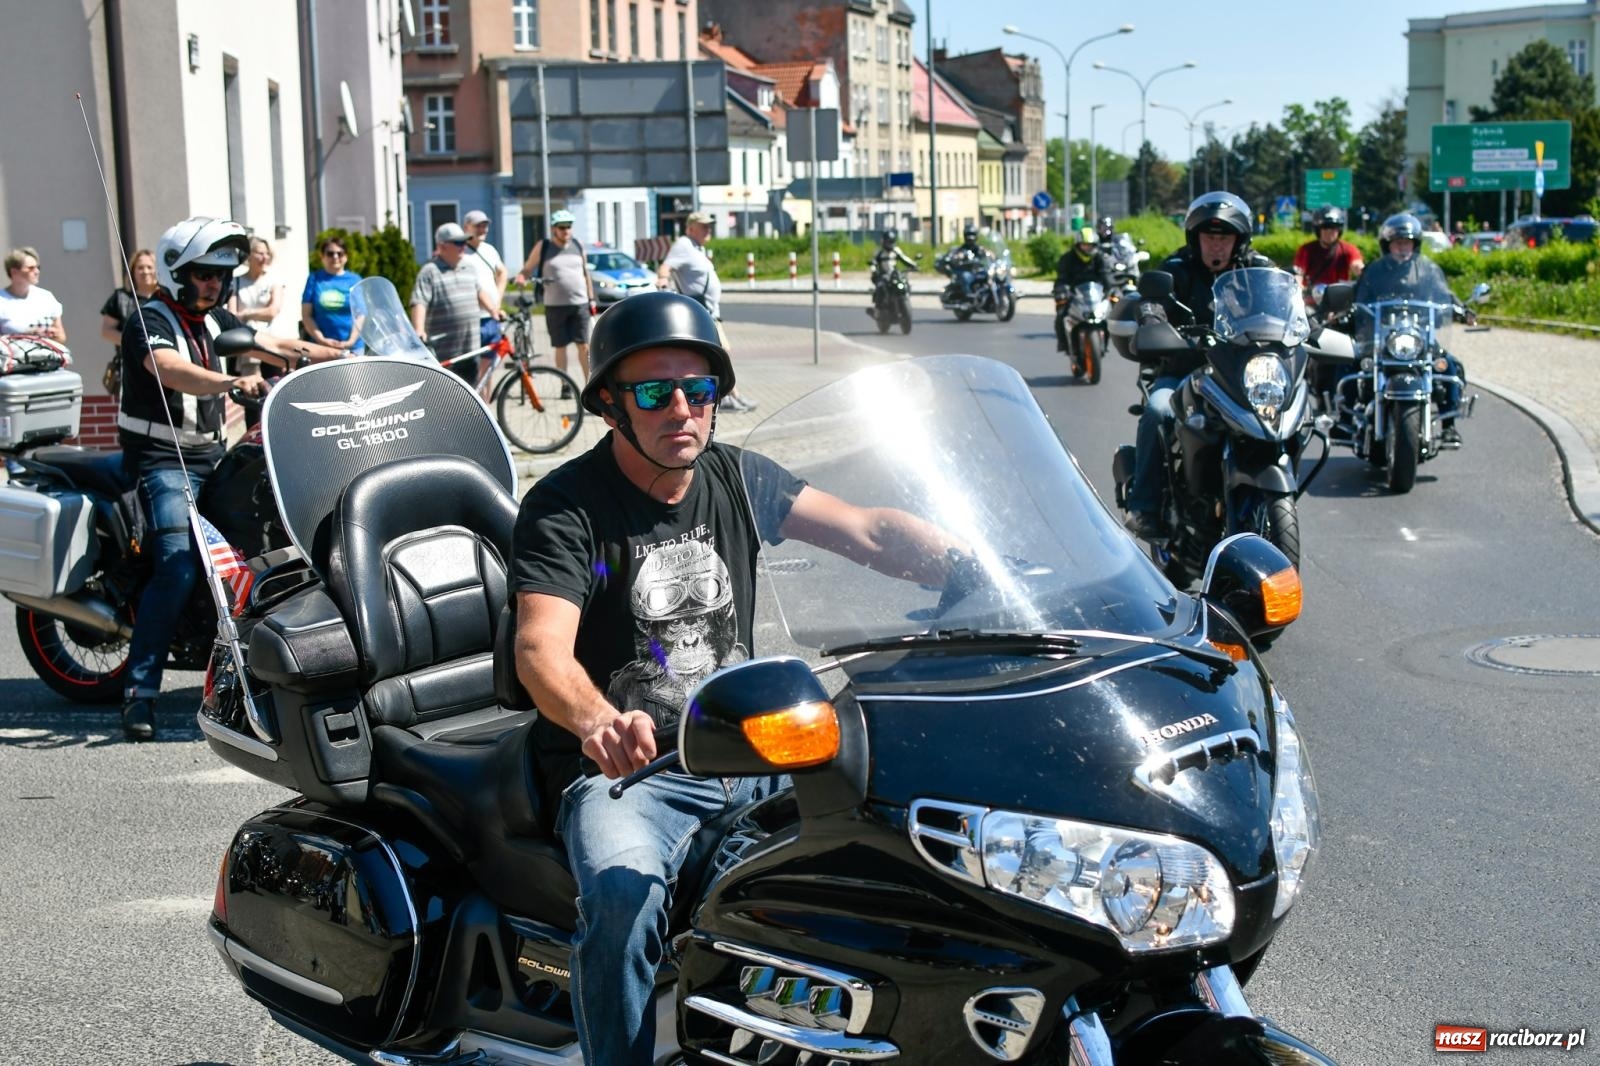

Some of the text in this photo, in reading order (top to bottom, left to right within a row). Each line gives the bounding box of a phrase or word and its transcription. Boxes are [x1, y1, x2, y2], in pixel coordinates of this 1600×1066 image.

[311, 409, 425, 438] GOLDWING
[660, 538, 677, 552] TO
[673, 549, 692, 564] TO
[1141, 713, 1220, 747] HONDA
